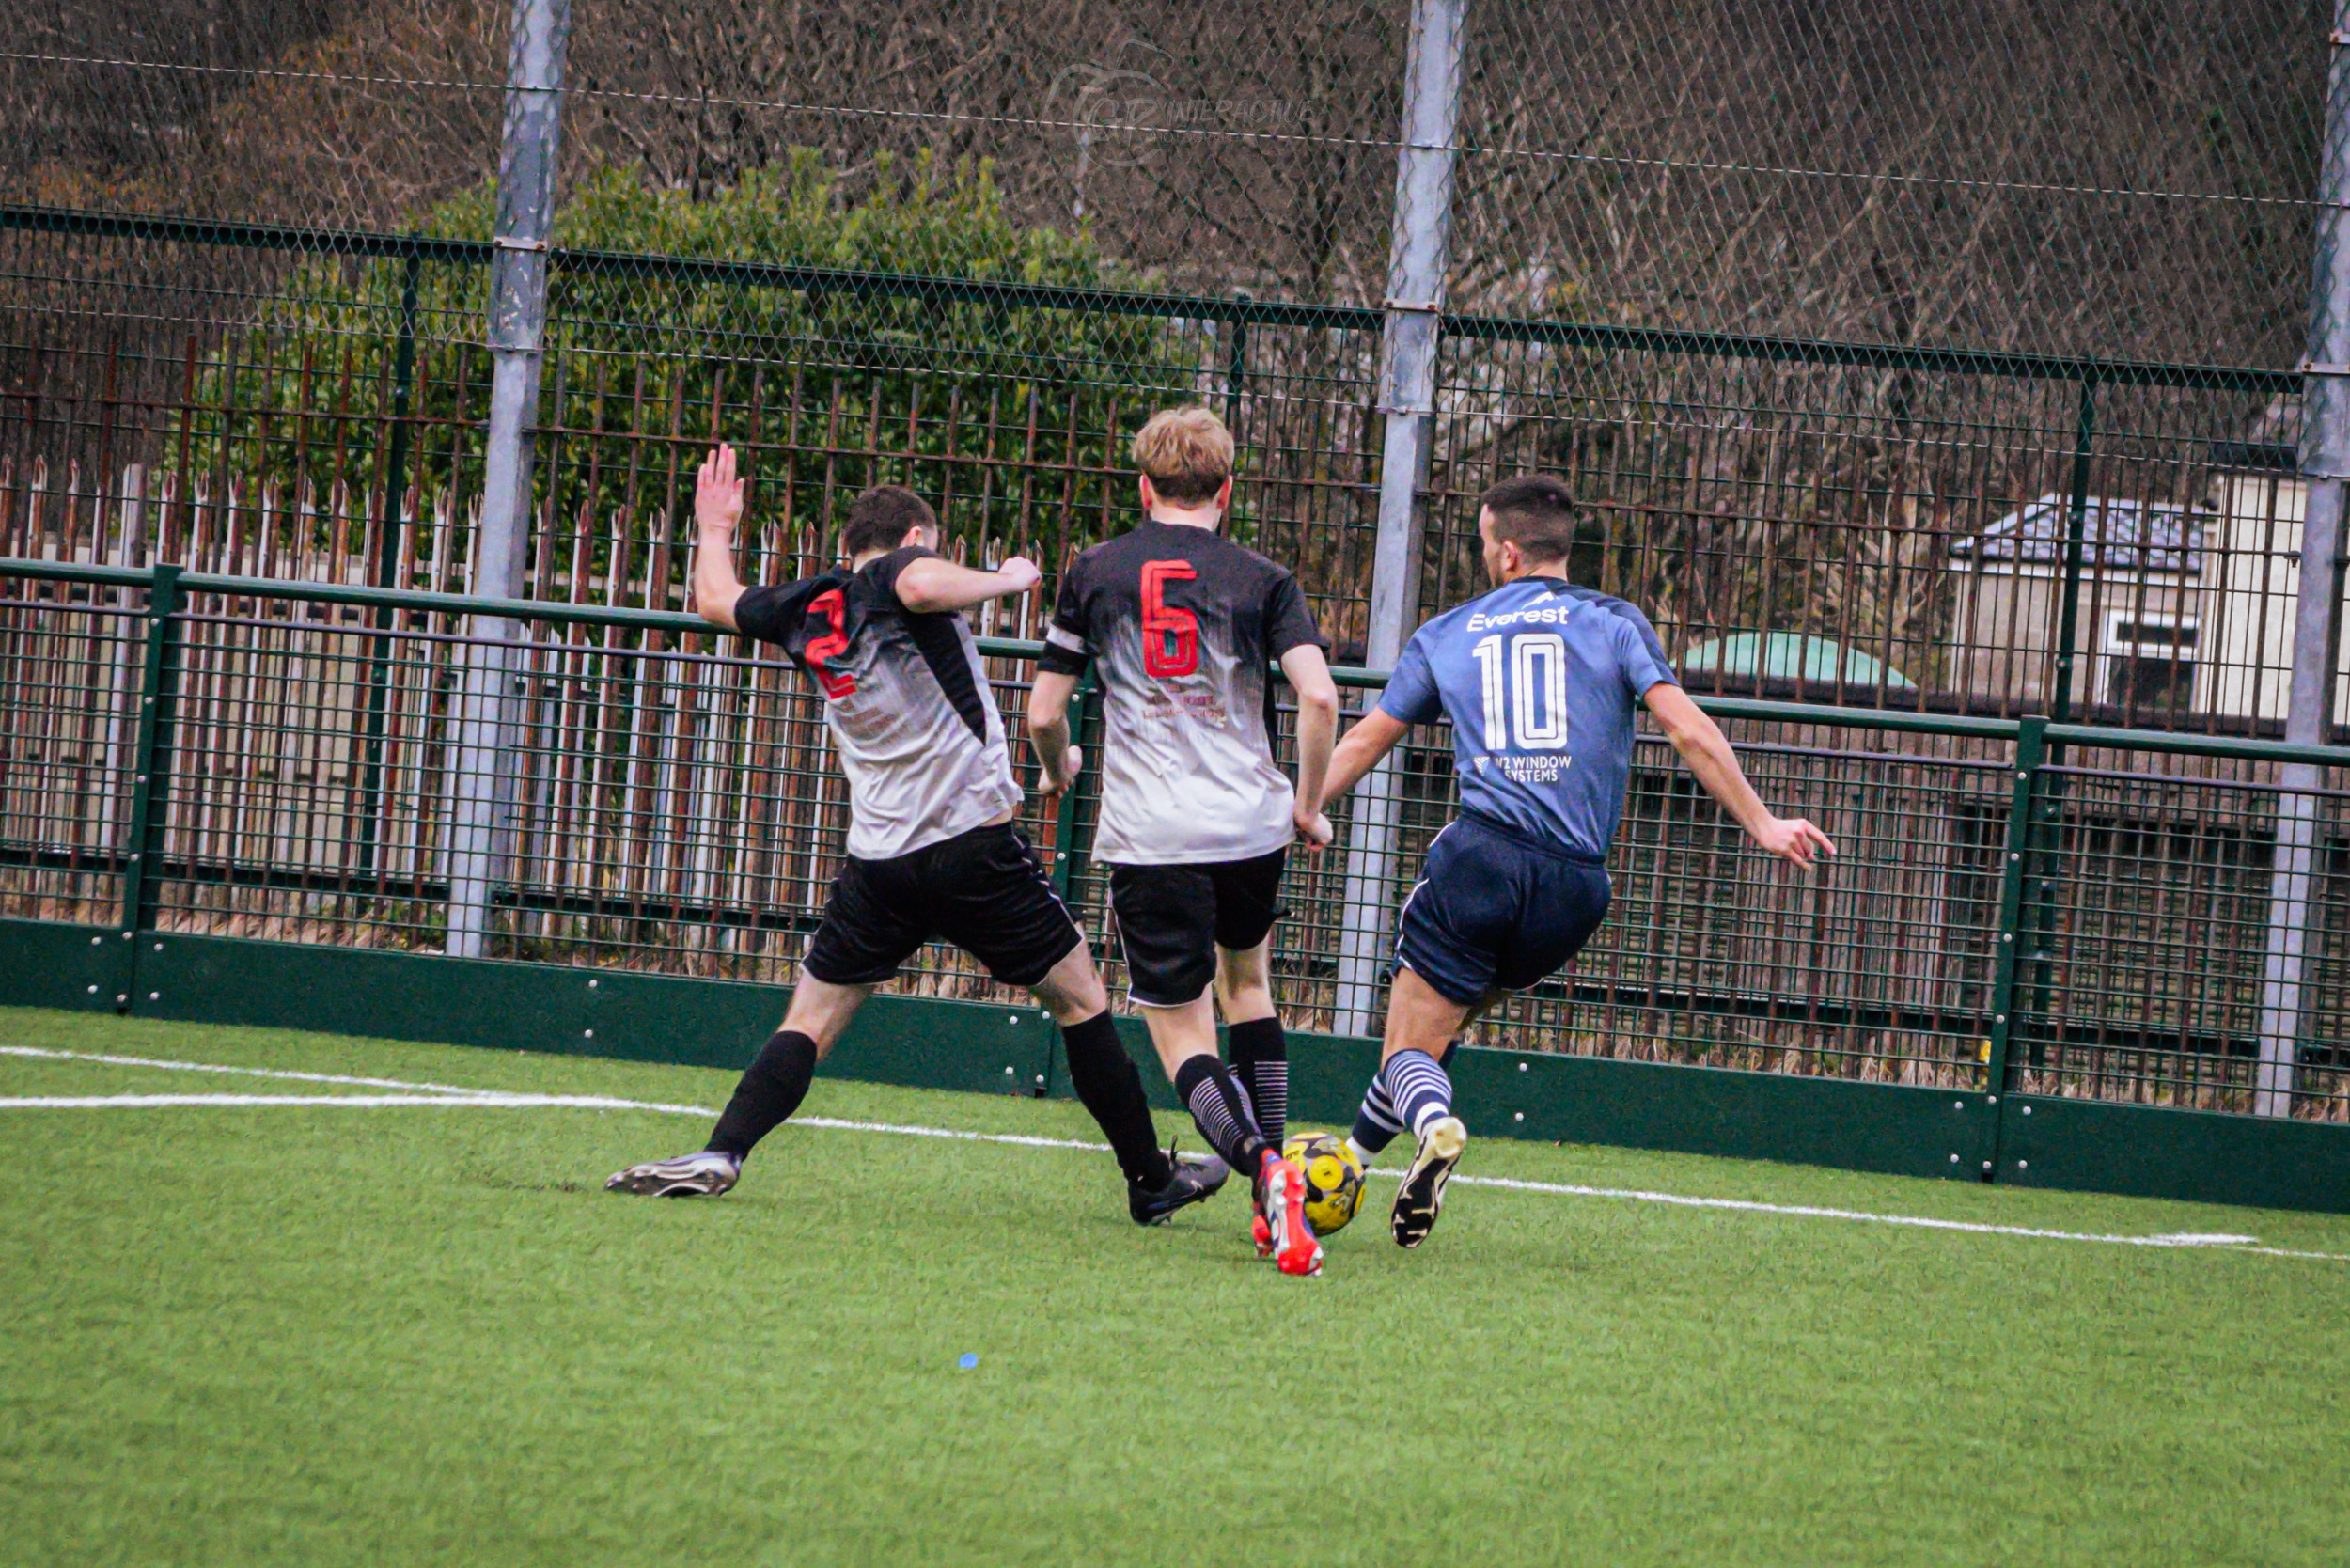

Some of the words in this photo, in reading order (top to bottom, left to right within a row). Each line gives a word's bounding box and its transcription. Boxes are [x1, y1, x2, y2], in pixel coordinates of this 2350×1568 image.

[1140, 559, 1198, 678] 6
[1466, 605, 1570, 632] Everest
[1472, 633, 1568, 750] 10
[1504, 768, 1558, 782] SYSTEMS
[1512, 755, 1573, 769] WINDOW
